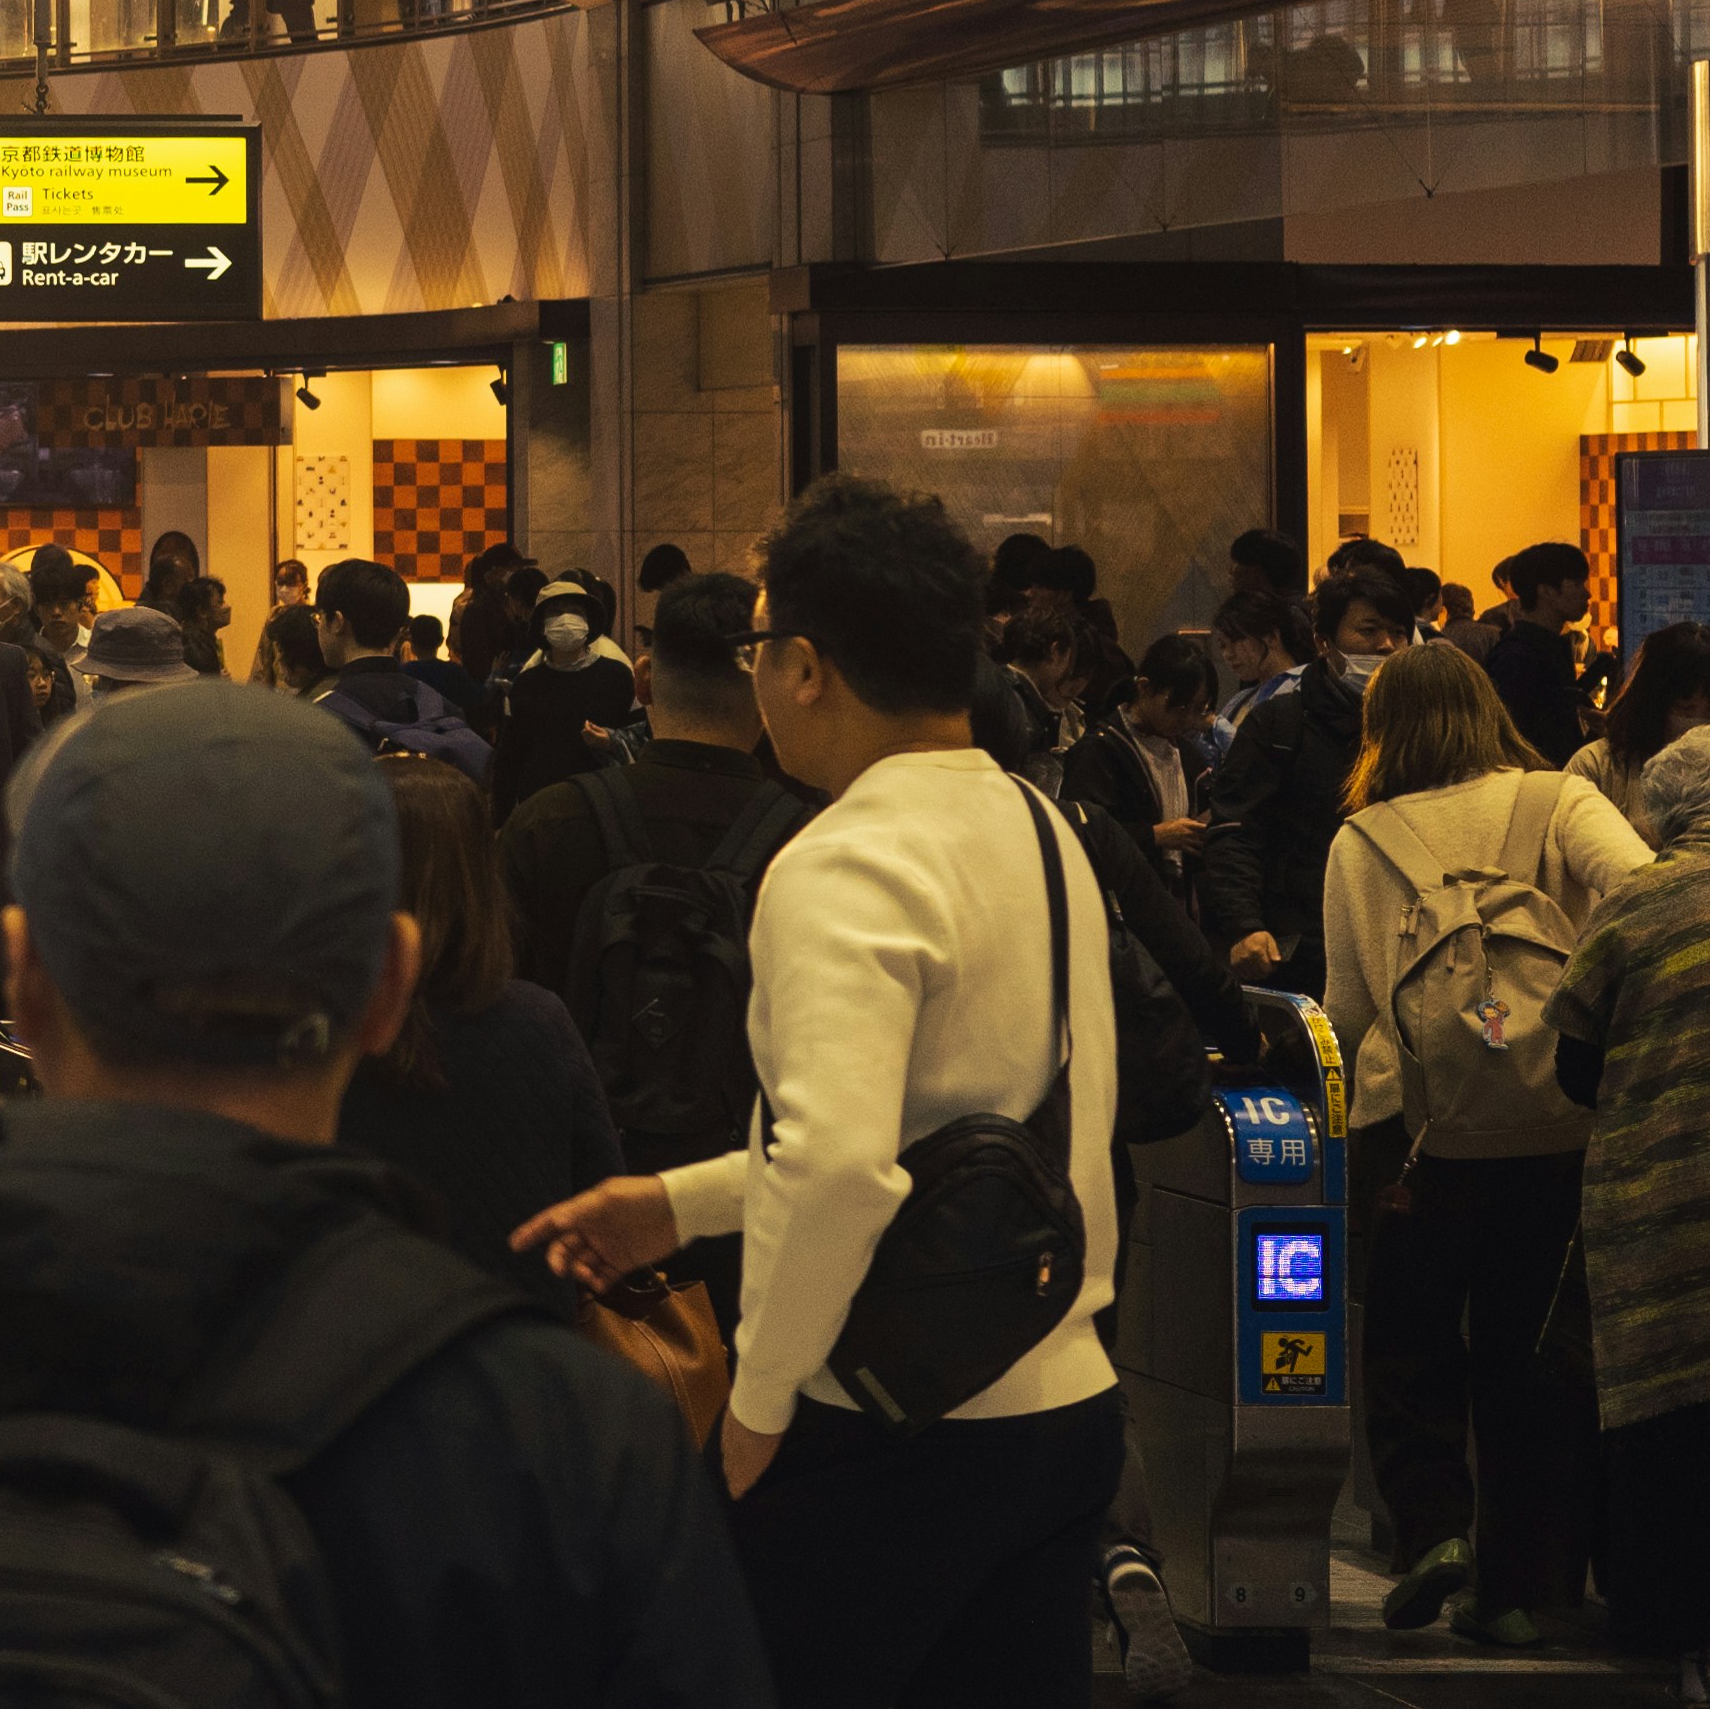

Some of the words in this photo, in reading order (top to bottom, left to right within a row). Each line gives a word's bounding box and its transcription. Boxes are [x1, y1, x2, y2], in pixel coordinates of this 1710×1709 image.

[1, 146, 145, 163] 京都鉄道博物館
[49, 166, 103, 180] railway
[109, 168, 172, 177] museum
[8, 191, 28, 201] Rail
[42, 189, 93, 201] Tickets
[7, 203, 29, 213] Pass
[22, 242, 173, 265] 駅レンタカー
[22, 271, 119, 286] Rent-a-car
[84, 393, 152, 431] CLUB
[1242, 1097, 1290, 1125] IC
[1247, 1139, 1306, 1166] 専用
[1263, 1240, 1319, 1295] IC
